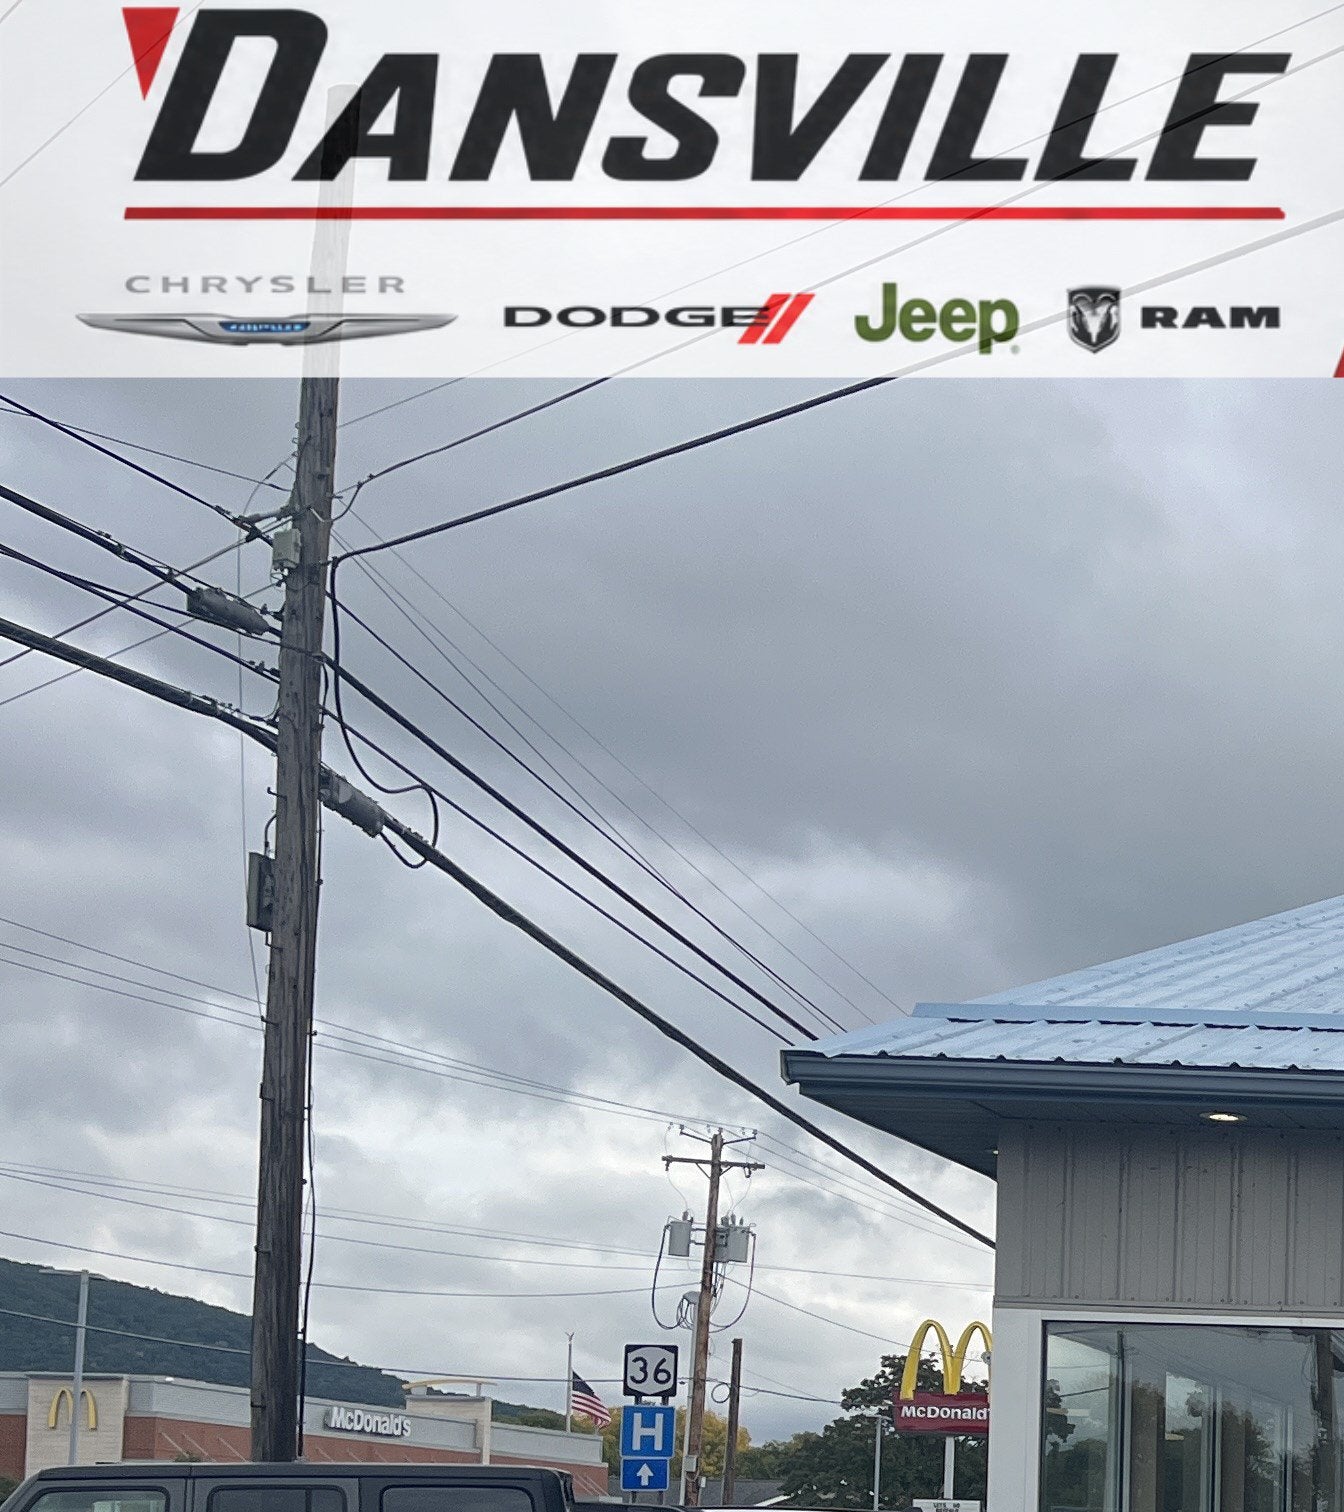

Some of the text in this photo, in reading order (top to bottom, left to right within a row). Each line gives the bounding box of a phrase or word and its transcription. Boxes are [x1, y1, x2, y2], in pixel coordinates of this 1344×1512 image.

[630, 1356, 671, 1385] 36
[330, 1406, 411, 1437] McDonald's
[632, 1412, 664, 1451] H
